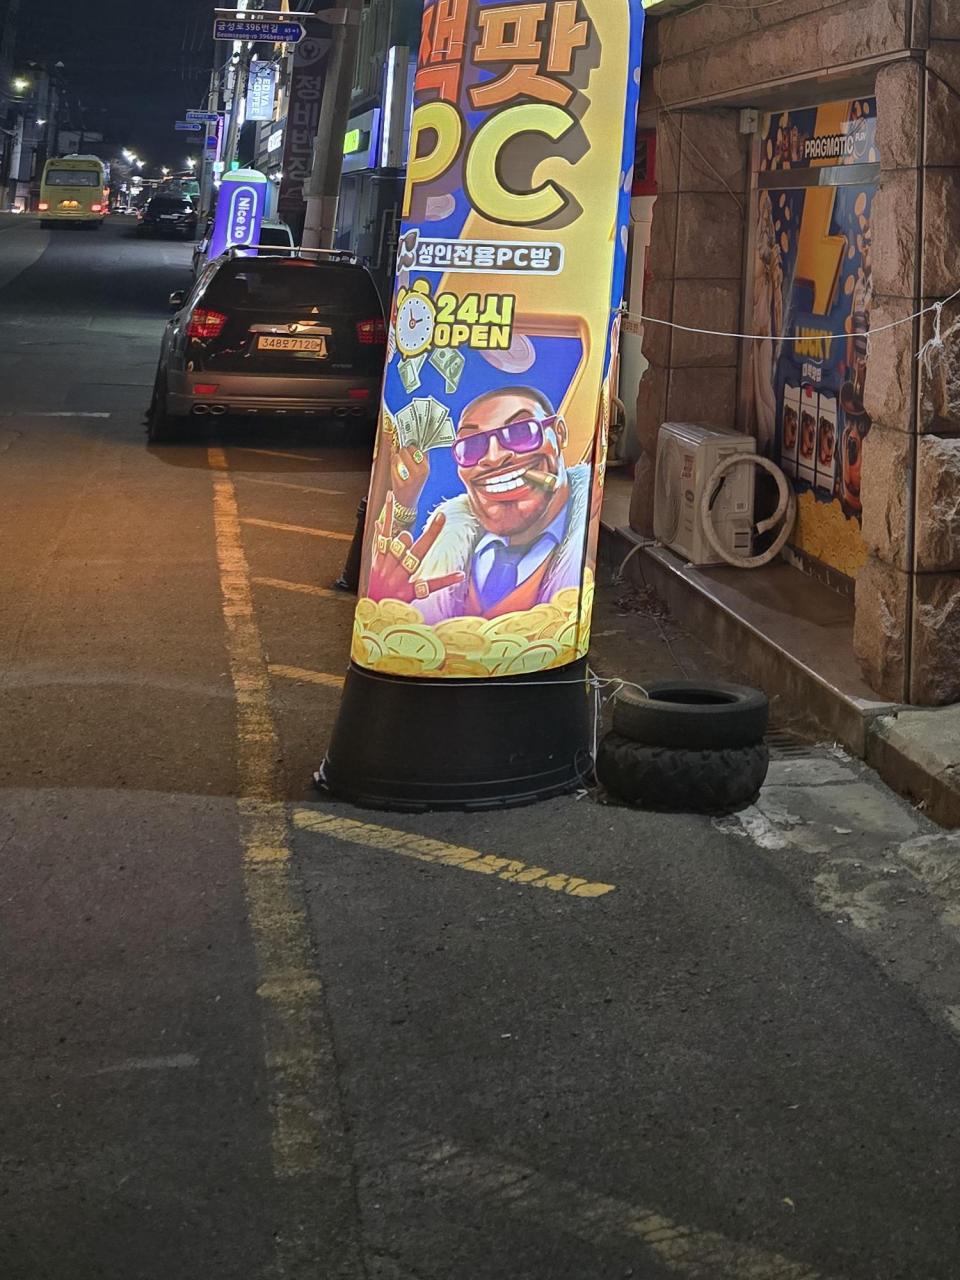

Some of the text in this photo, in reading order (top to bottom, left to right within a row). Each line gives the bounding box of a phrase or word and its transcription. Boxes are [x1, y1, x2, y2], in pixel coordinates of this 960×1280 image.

[252, 77, 262, 114] COFFEE
[261, 78, 271, 107] EDIYA
[402, 102, 575, 222] PC
[804, 135, 853, 158] PRAGMATIC
[234, 197, 251, 239] Nice to
[417, 244, 552, 268] 성인전용PC방
[437, 293, 513, 325] 24시
[434, 324, 510, 348] OPEN
[794, 326, 833, 360] LUCKY
